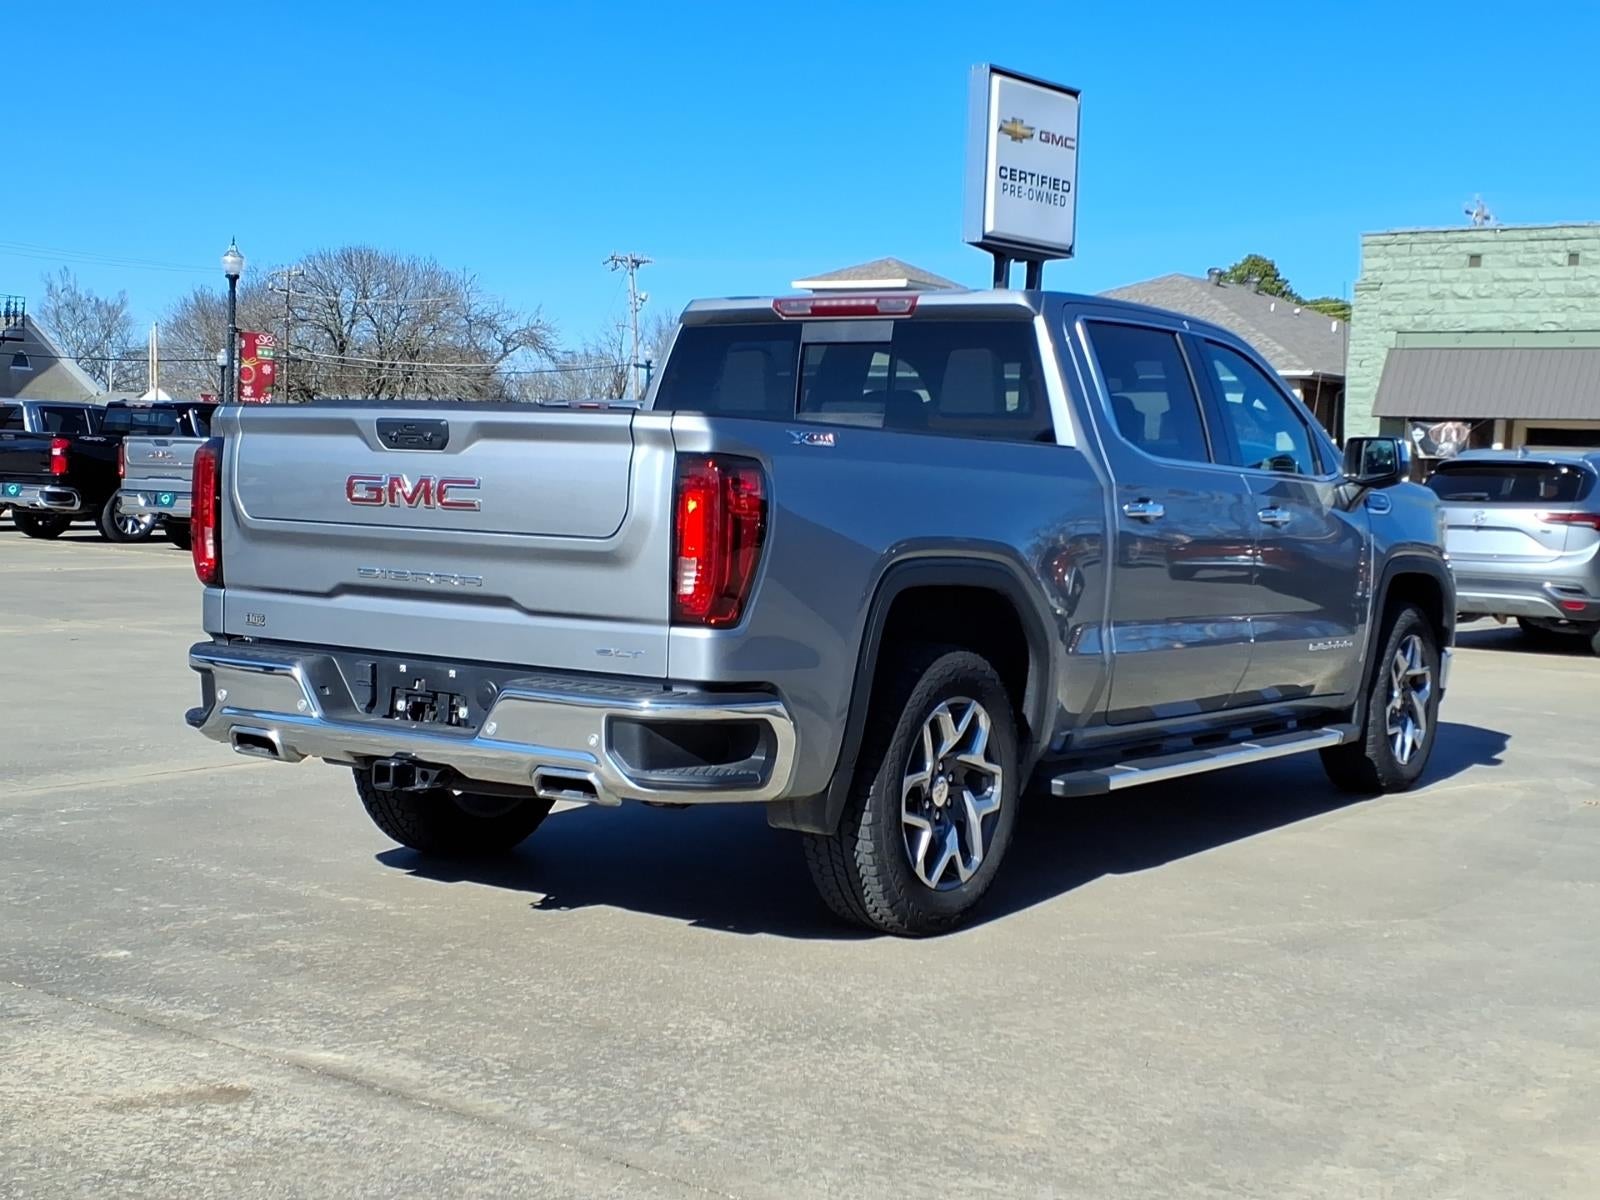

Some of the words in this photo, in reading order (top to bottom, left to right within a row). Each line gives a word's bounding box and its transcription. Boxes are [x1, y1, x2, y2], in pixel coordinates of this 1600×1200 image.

[1039, 130, 1075, 150] GMC
[998, 166, 1071, 193] CERTIFIED
[1002, 182, 1067, 208] PRE-OWNED
[346, 473, 481, 511] GMC
[357, 567, 483, 587] SIERRA
